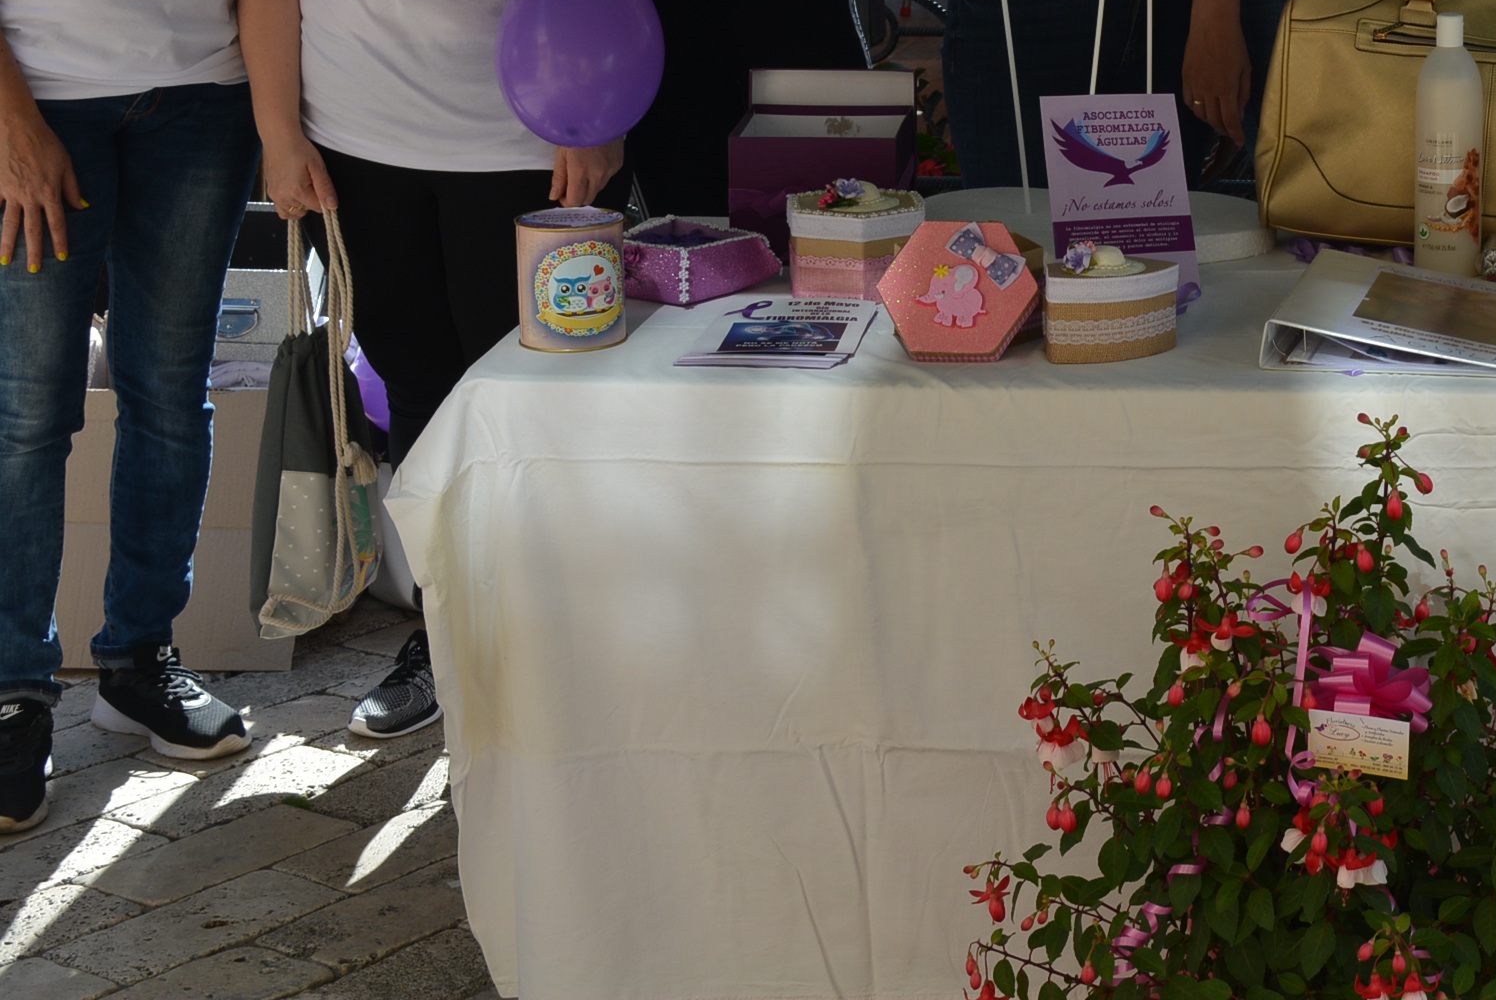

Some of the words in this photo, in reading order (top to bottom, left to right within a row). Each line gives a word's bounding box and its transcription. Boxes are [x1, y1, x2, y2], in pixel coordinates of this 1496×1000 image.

[1083, 107, 1155, 121] ASOCIACIÓN
[1077, 123, 1165, 134] FIBROMIALGIA
[1096, 135, 1148, 147] ÁGUILAS
[1093, 198, 1137, 211] estamos
[1141, 189, 1175, 209] solos!
[0, 703, 21, 714] NIKE
